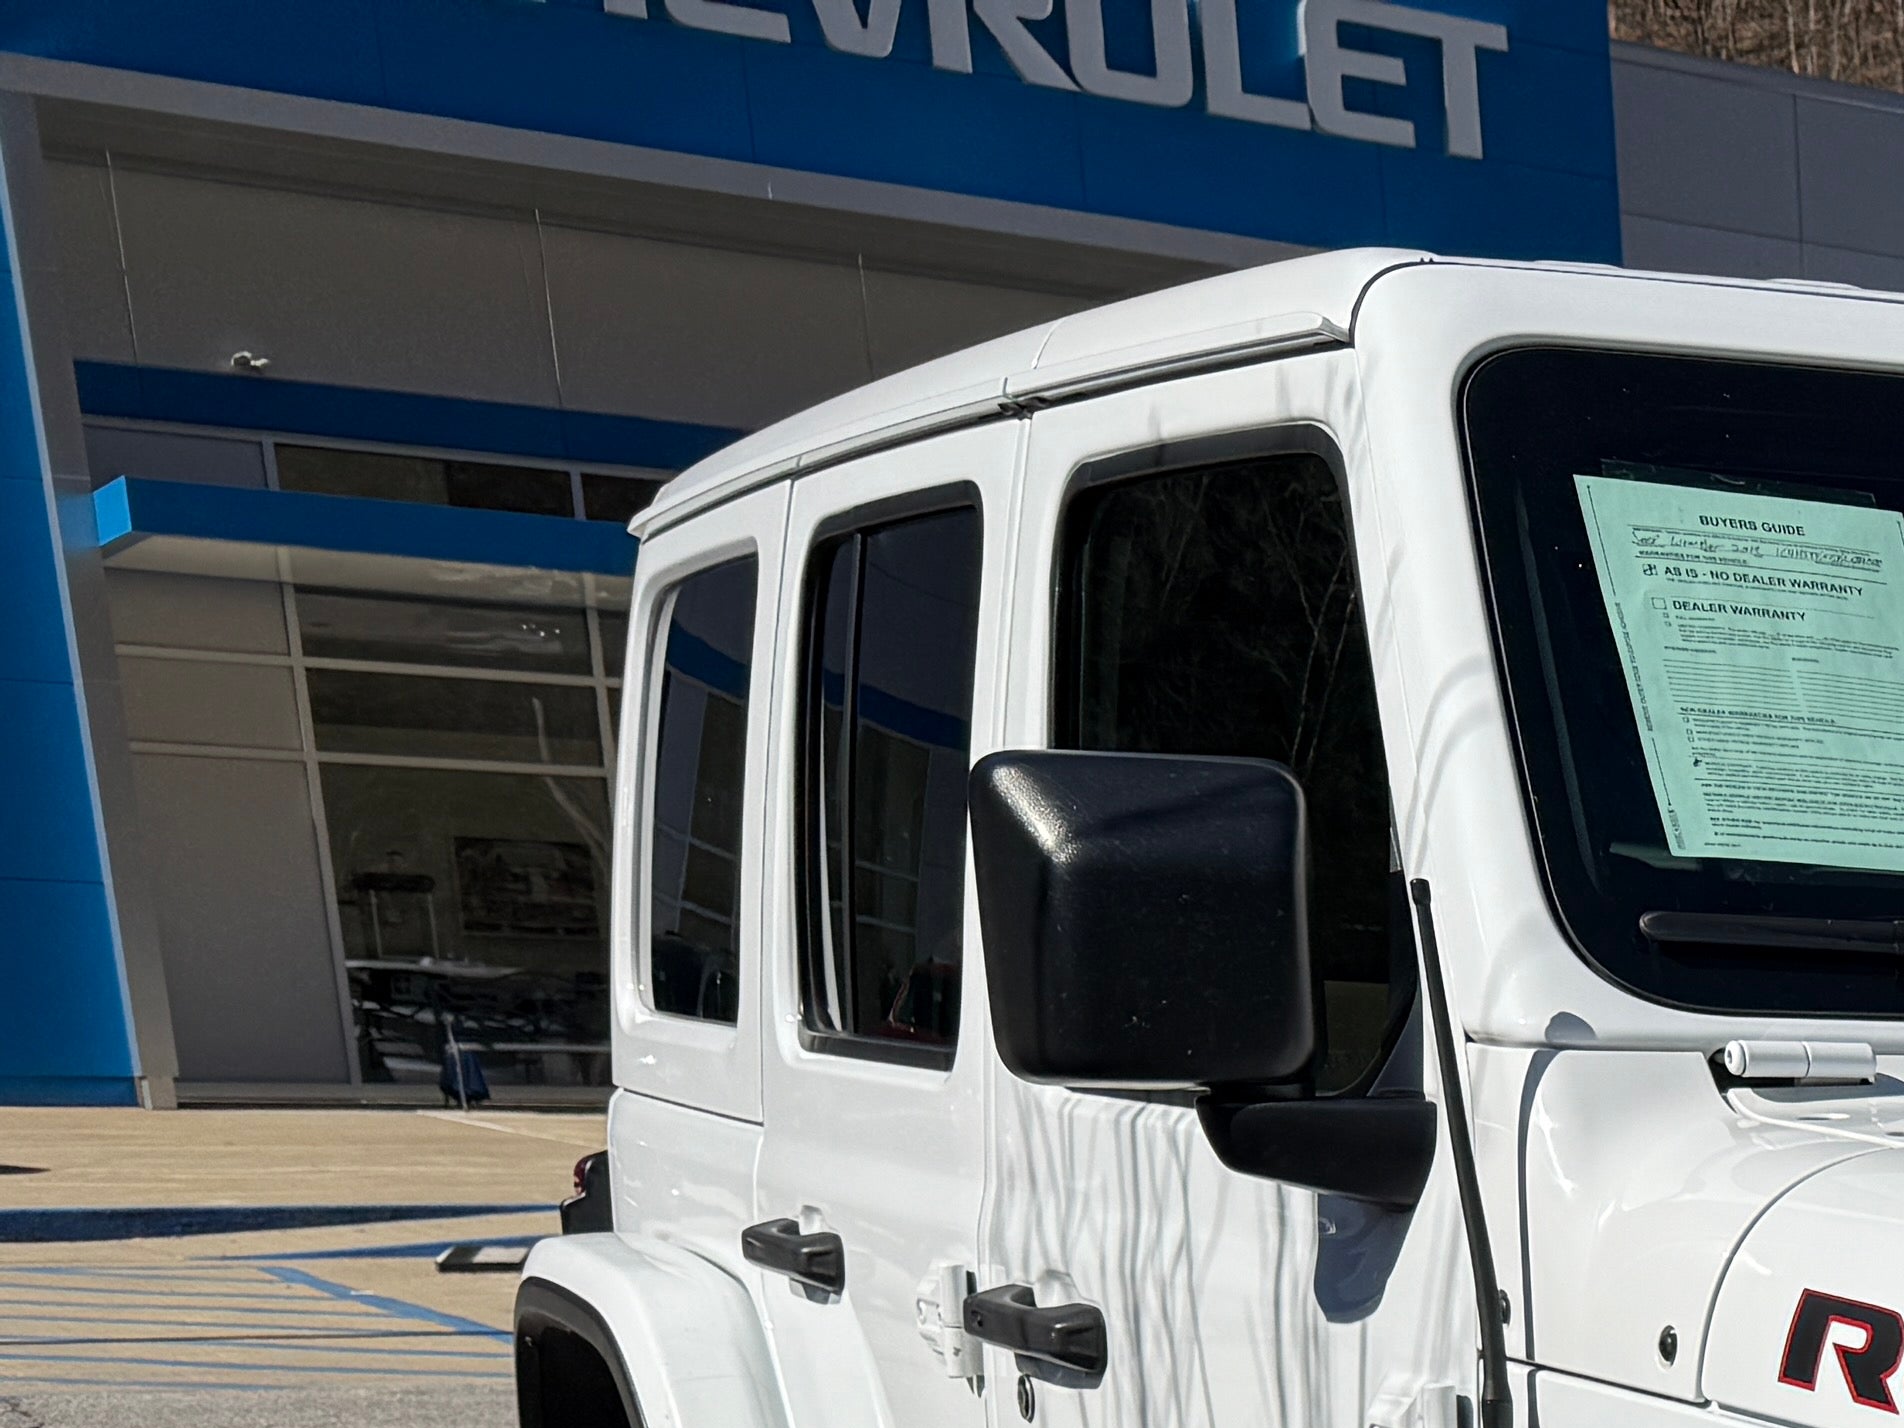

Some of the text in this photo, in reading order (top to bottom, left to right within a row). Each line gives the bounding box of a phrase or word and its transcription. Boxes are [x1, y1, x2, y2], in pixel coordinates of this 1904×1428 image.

[1698, 514, 1806, 537] BUYERS GUIDE
[1664, 566, 1682, 577] AS
[1685, 568, 1699, 578] IS
[1709, 570, 1730, 581] NO
[1732, 571, 1787, 587] DEALER
[1788, 578, 1863, 596] WARRANTY
[1672, 600, 1728, 614] DEALER
[1730, 604, 1806, 622] WARRANTY
